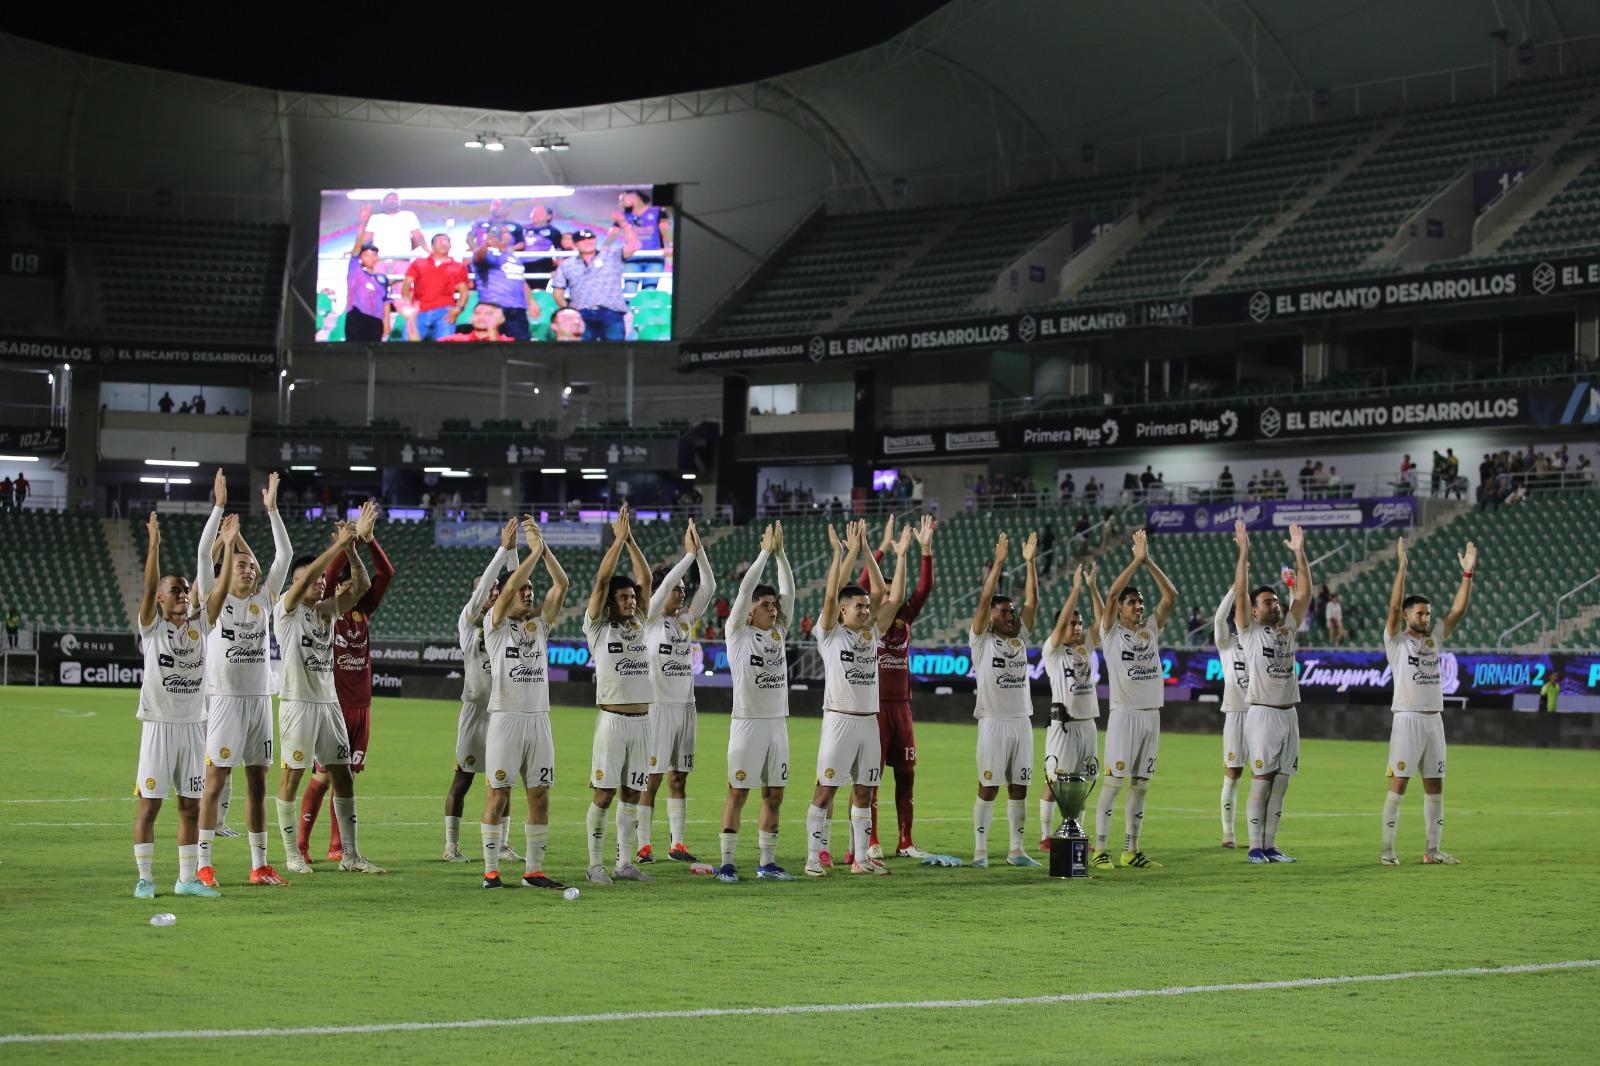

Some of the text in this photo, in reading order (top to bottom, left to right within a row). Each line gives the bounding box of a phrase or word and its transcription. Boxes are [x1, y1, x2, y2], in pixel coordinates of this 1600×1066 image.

[11, 253, 39, 272] 09
[1562, 266, 1583, 286] EL
[1276, 273, 1517, 314] EL ENCANTO DESARROLLOS
[1041, 313, 1126, 335] EL ENCANTO
[829, 324, 1009, 356] EL ENCANTO DESARROLLOS
[119, 352, 275, 365] EL ENCANTO DESARROLLOS
[691, 344, 804, 362] EL ENCANTO DESARROLLOS
[1286, 398, 1519, 430] EL ENCANTO DESARROLLOS
[1024, 426, 1101, 443] Primera Plus
[1136, 418, 1220, 438] Primera Plus
[19, 430, 52, 449] 102.7
[384, 648, 419, 660] Azteca
[1299, 659, 1392, 692] Inaugural
[1472, 663, 1546, 688] JORNADA 2
[264, 740, 272, 759] 17
[905, 747, 916, 761] 13
[684, 754, 694, 768] 13
[540, 767, 553, 782] 21
[869, 768, 881, 782] 17
